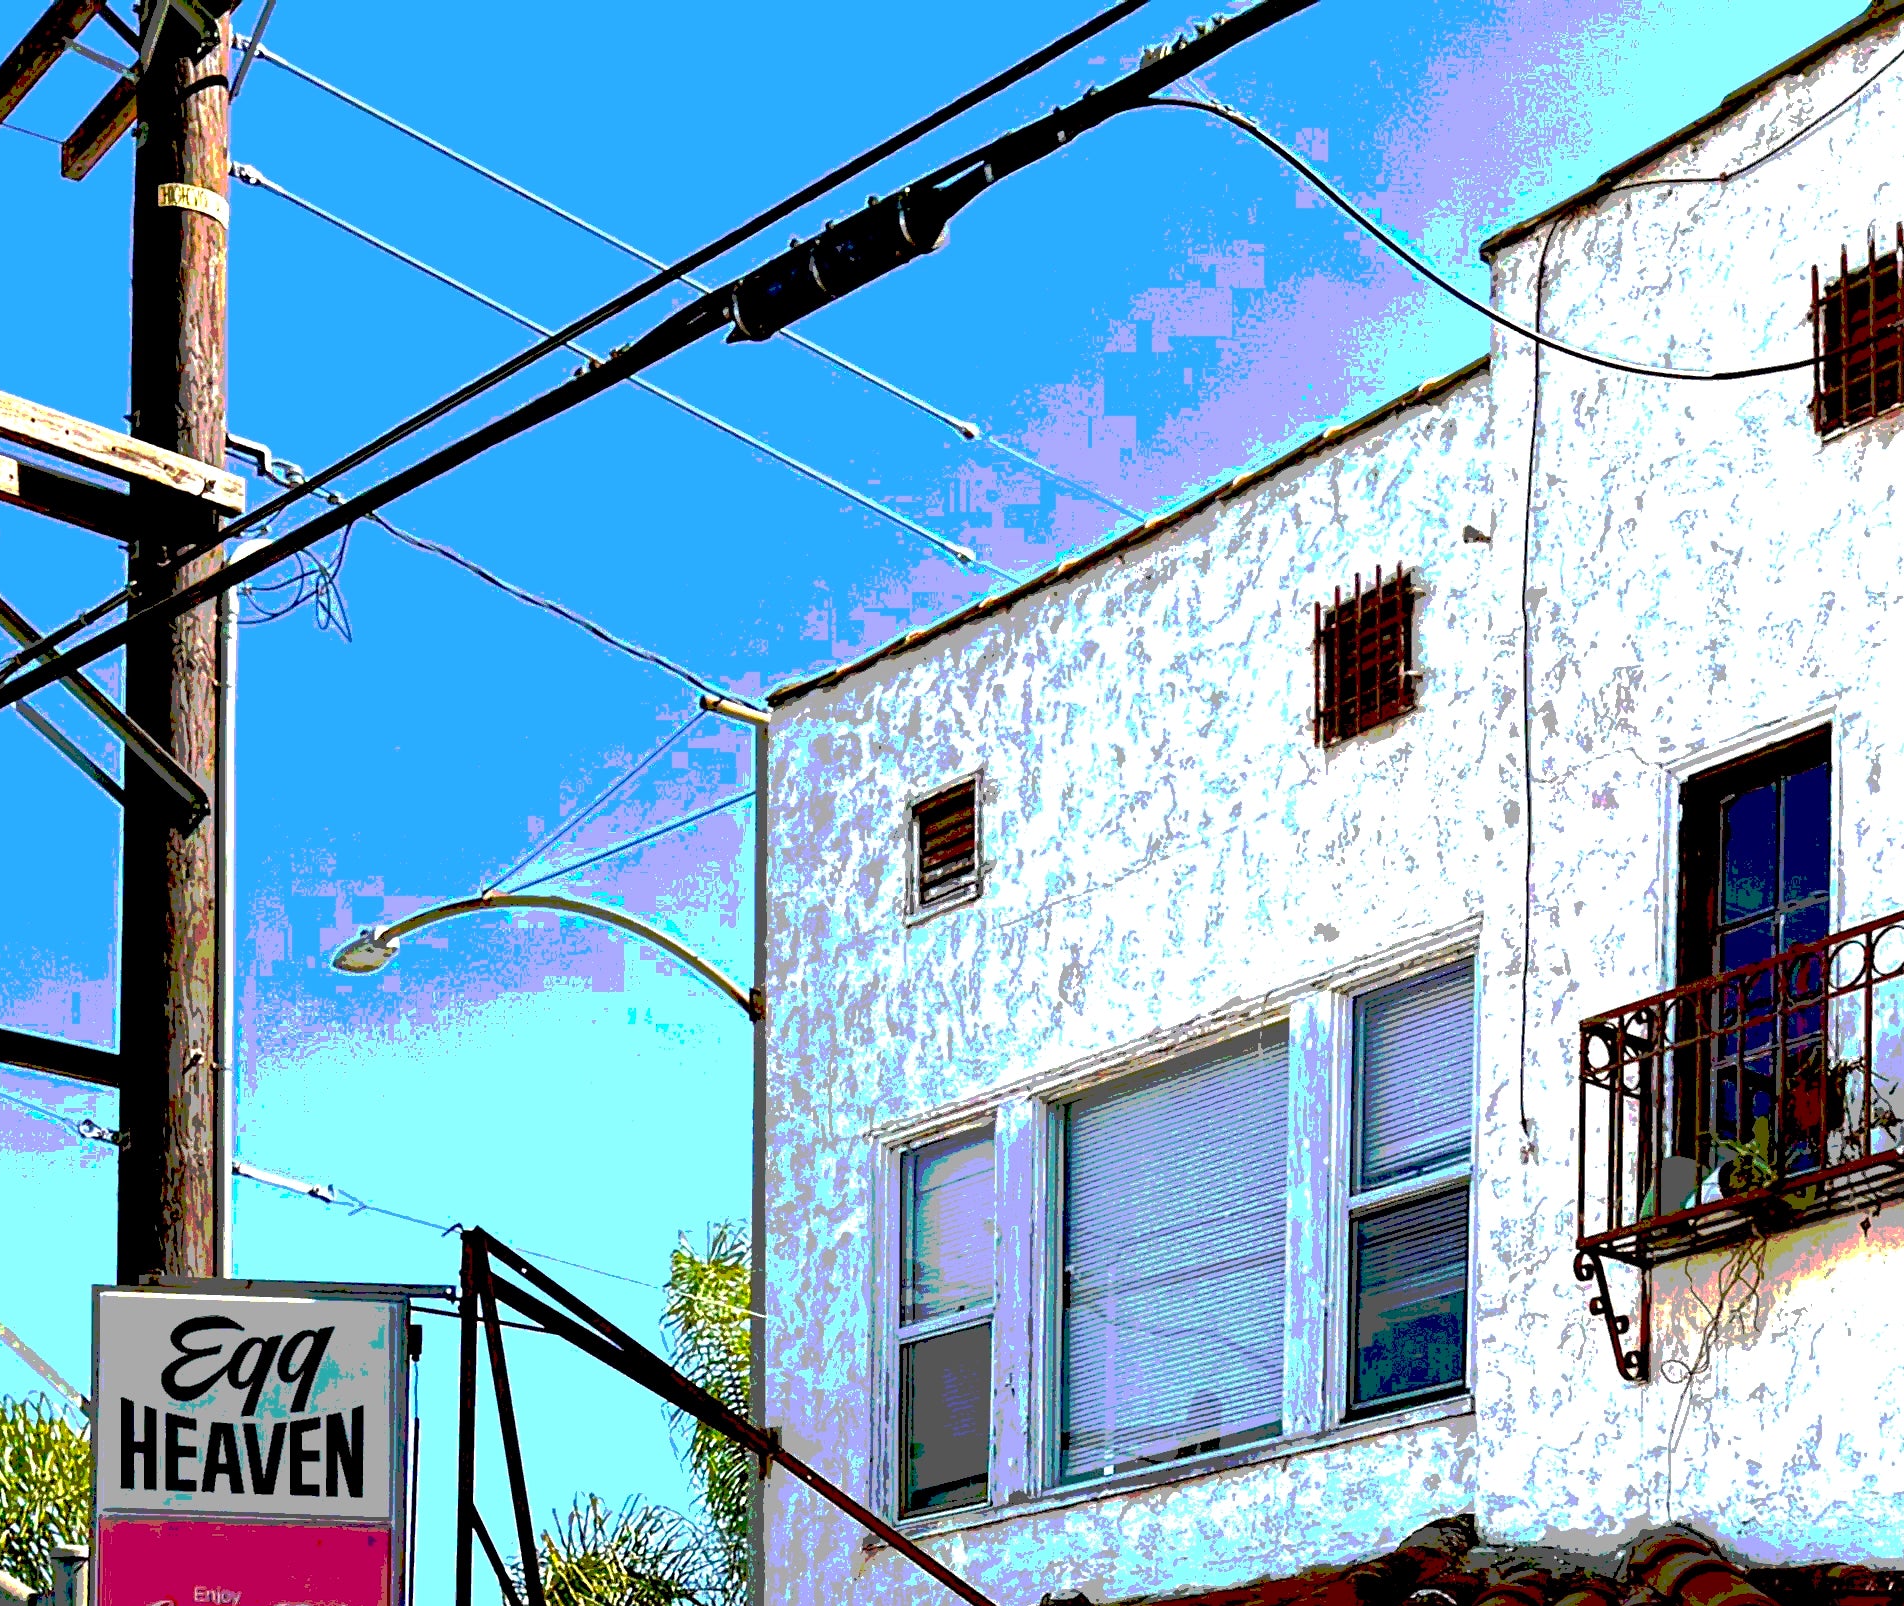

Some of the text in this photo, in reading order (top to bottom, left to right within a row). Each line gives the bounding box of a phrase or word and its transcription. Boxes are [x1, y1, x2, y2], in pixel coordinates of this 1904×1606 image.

[161, 1315, 335, 1416] Egg
[120, 1397, 364, 1498] HEAVEN
[194, 1586, 242, 1605] Enjoy
